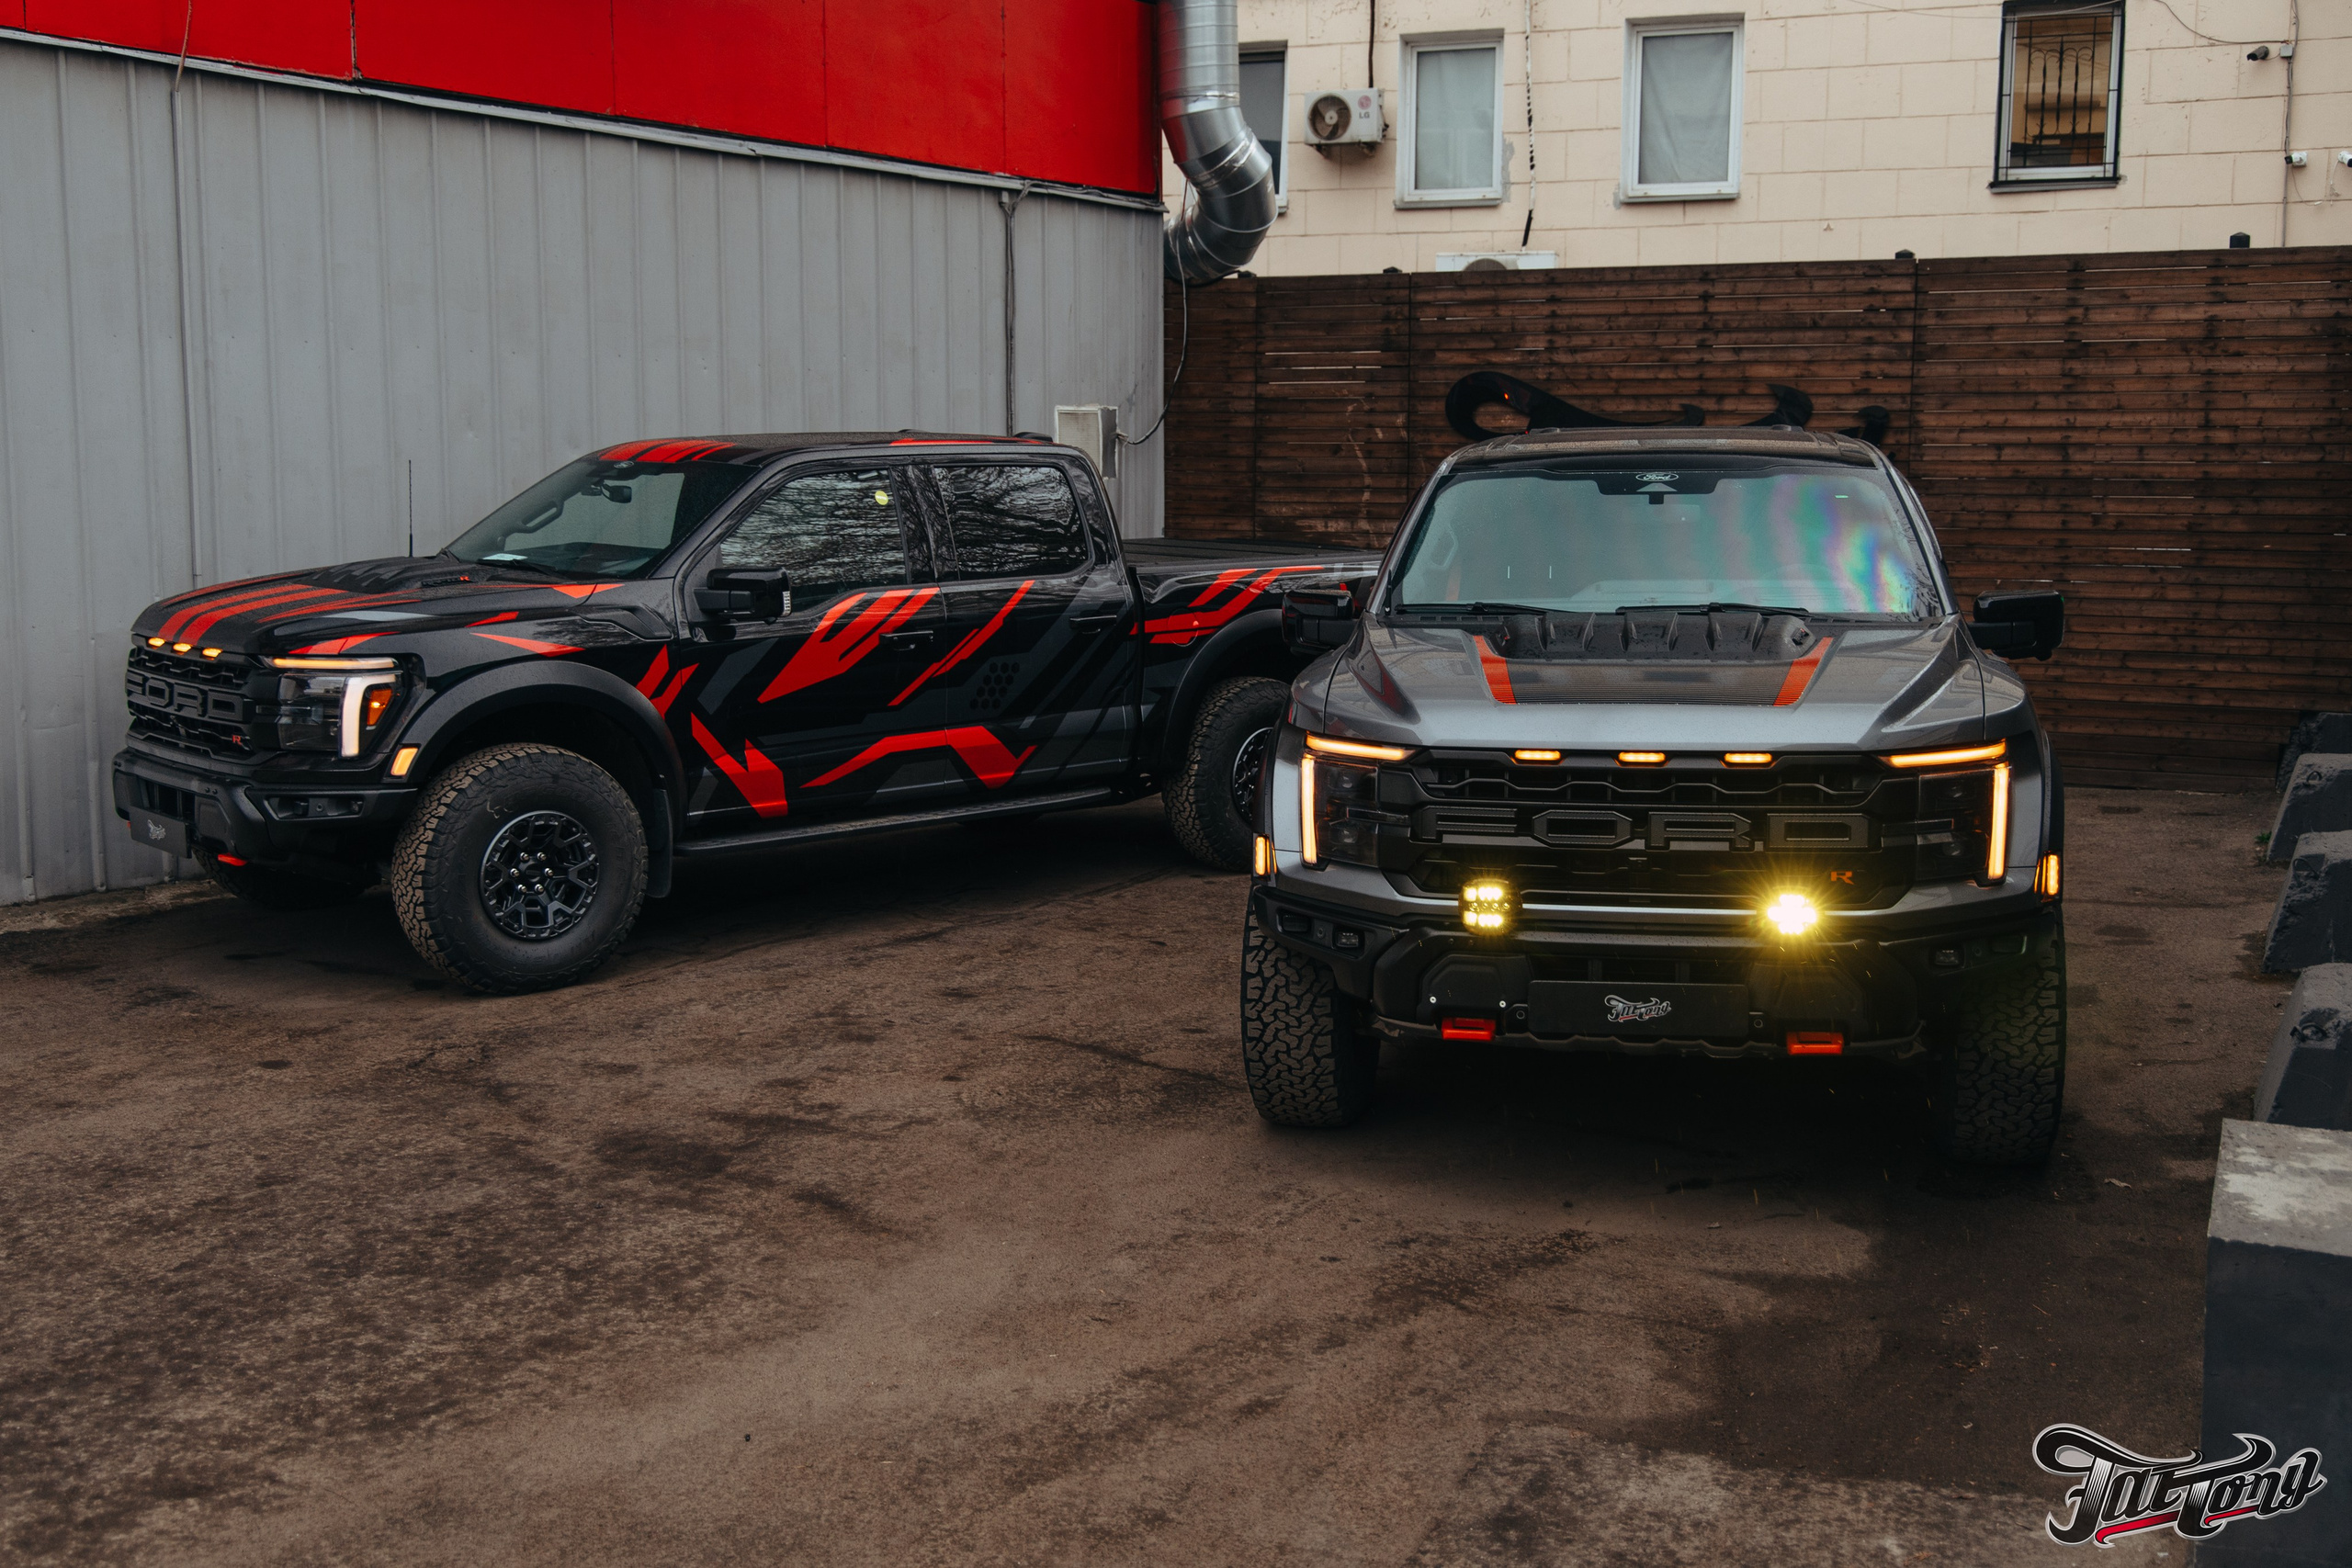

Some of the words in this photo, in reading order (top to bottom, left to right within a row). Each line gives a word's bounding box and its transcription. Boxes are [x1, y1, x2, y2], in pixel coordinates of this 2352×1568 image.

[1641, 473, 1673, 481] Ford
[125, 671, 244, 721] FORD
[1413, 805, 1871, 852] FORD
[1830, 871, 1855, 886] R
